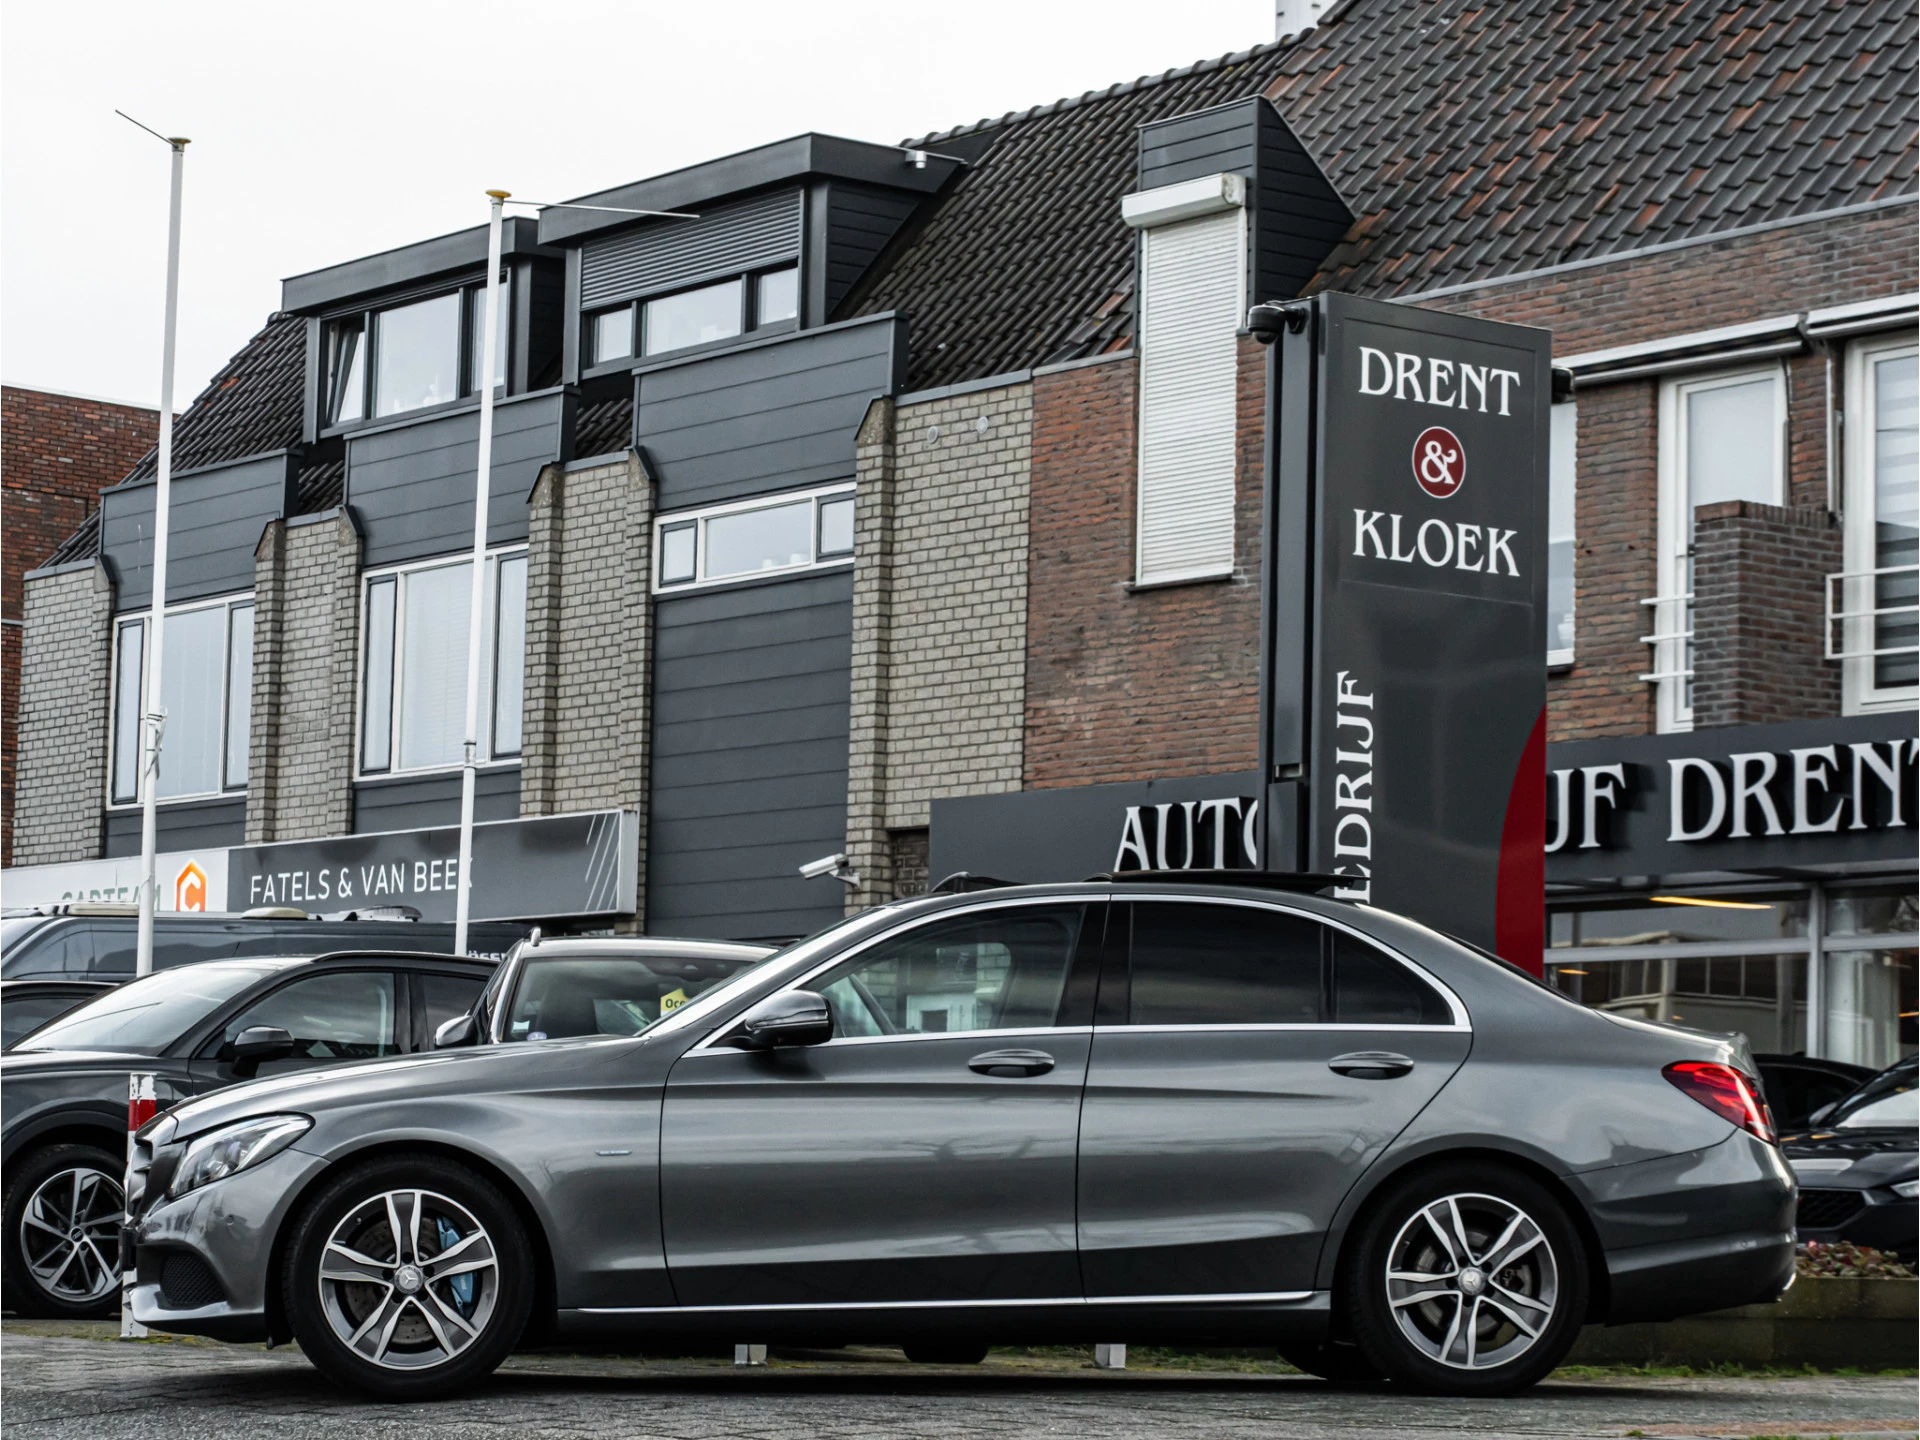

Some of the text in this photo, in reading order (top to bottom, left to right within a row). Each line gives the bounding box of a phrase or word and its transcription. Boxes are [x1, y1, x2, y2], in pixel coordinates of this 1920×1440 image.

[1358, 346, 1521, 416] DRENT
[1420, 440, 1457, 485] &
[1352, 509, 1521, 577] KLOEK
[1667, 738, 1920, 842] DREN
[250, 857, 473, 905] FATELS & VAN BEE
